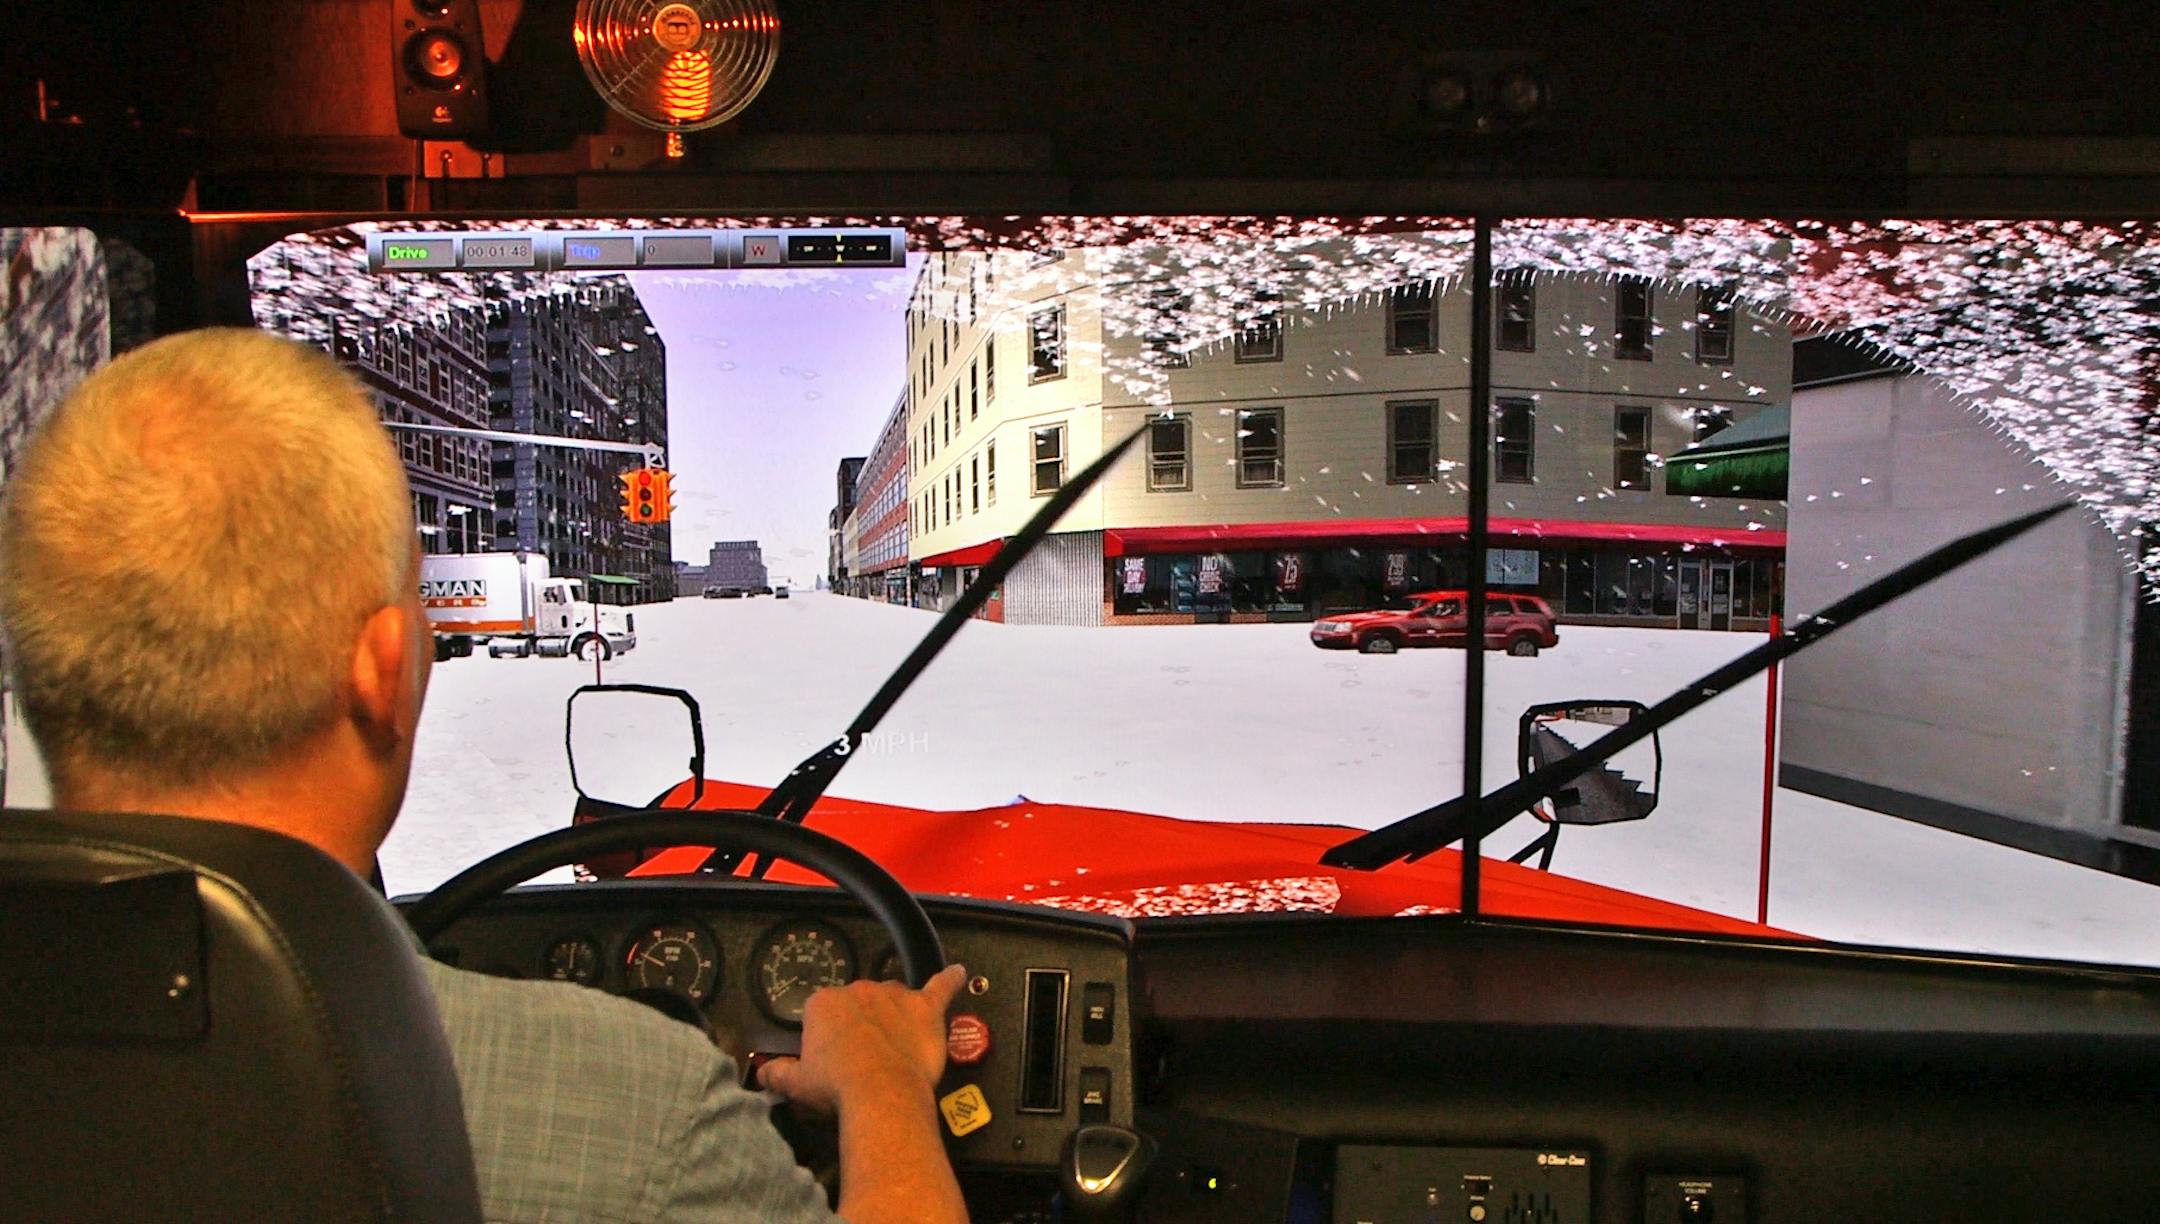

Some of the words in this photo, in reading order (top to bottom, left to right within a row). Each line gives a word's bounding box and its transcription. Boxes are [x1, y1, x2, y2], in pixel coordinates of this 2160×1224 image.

[388, 246, 428, 259] Drive
[751, 245, 766, 257] W
[1202, 556, 1217, 571] NO
[833, 733, 851, 756] 3
[861, 732, 929, 753] MPH
